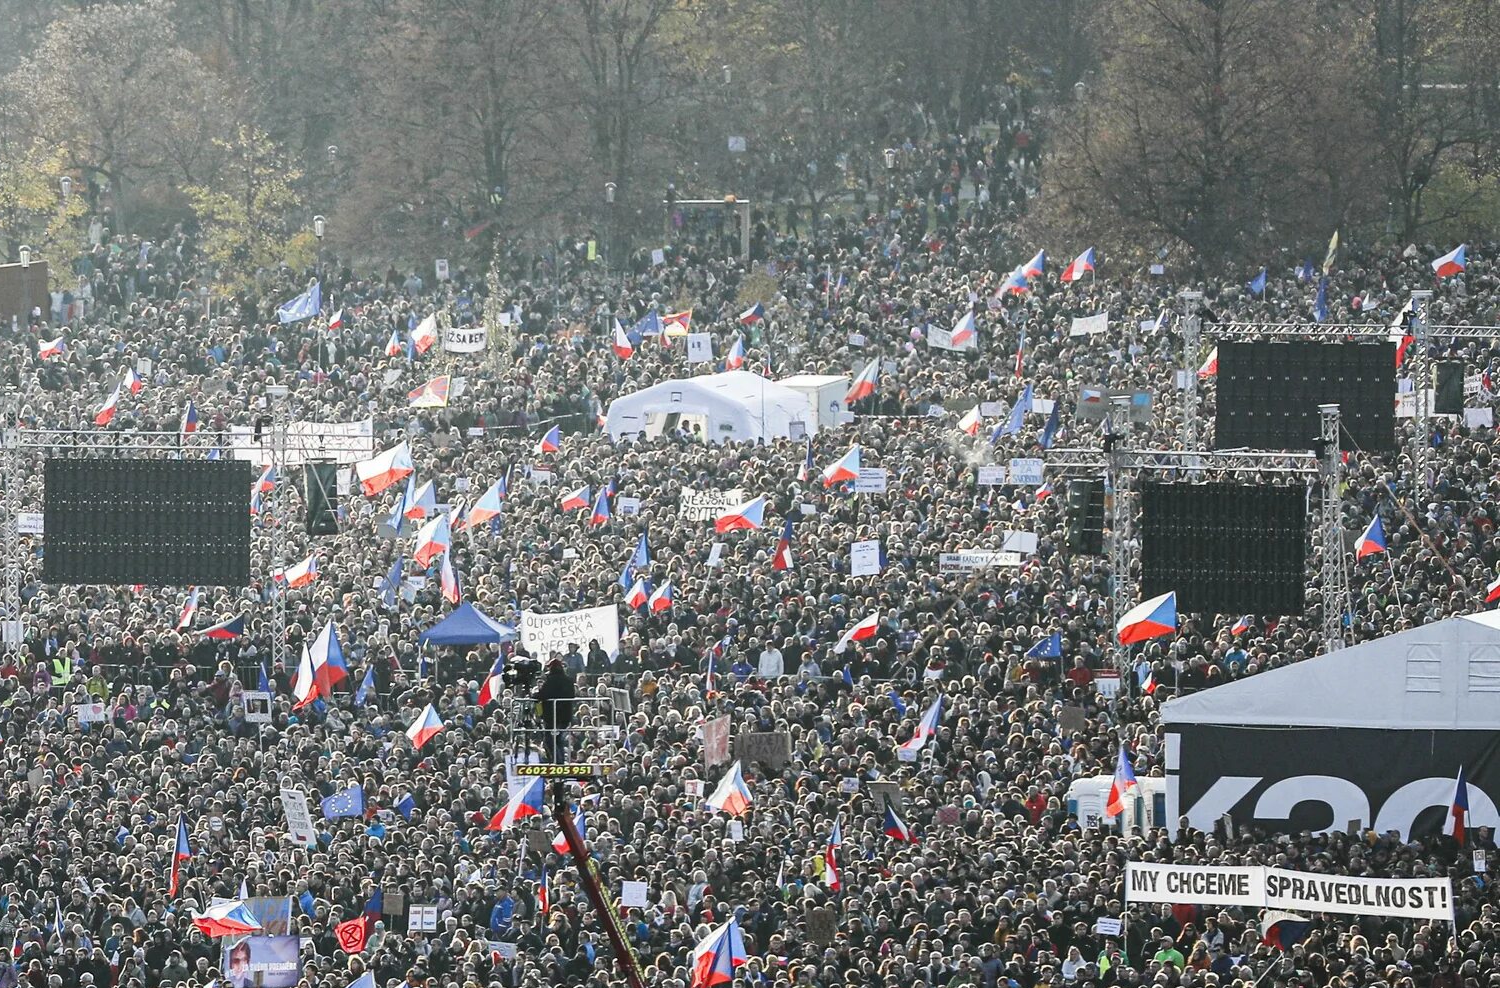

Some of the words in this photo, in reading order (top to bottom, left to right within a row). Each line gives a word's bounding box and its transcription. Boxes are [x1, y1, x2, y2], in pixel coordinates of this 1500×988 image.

[525, 766, 547, 775] 602
[549, 766, 571, 775] 205
[572, 766, 592, 775] 951
[1131, 871, 1160, 893] MY
[1166, 872, 1250, 897] CHCEME
[1266, 873, 1450, 910] SPRAVEDLNOST!
